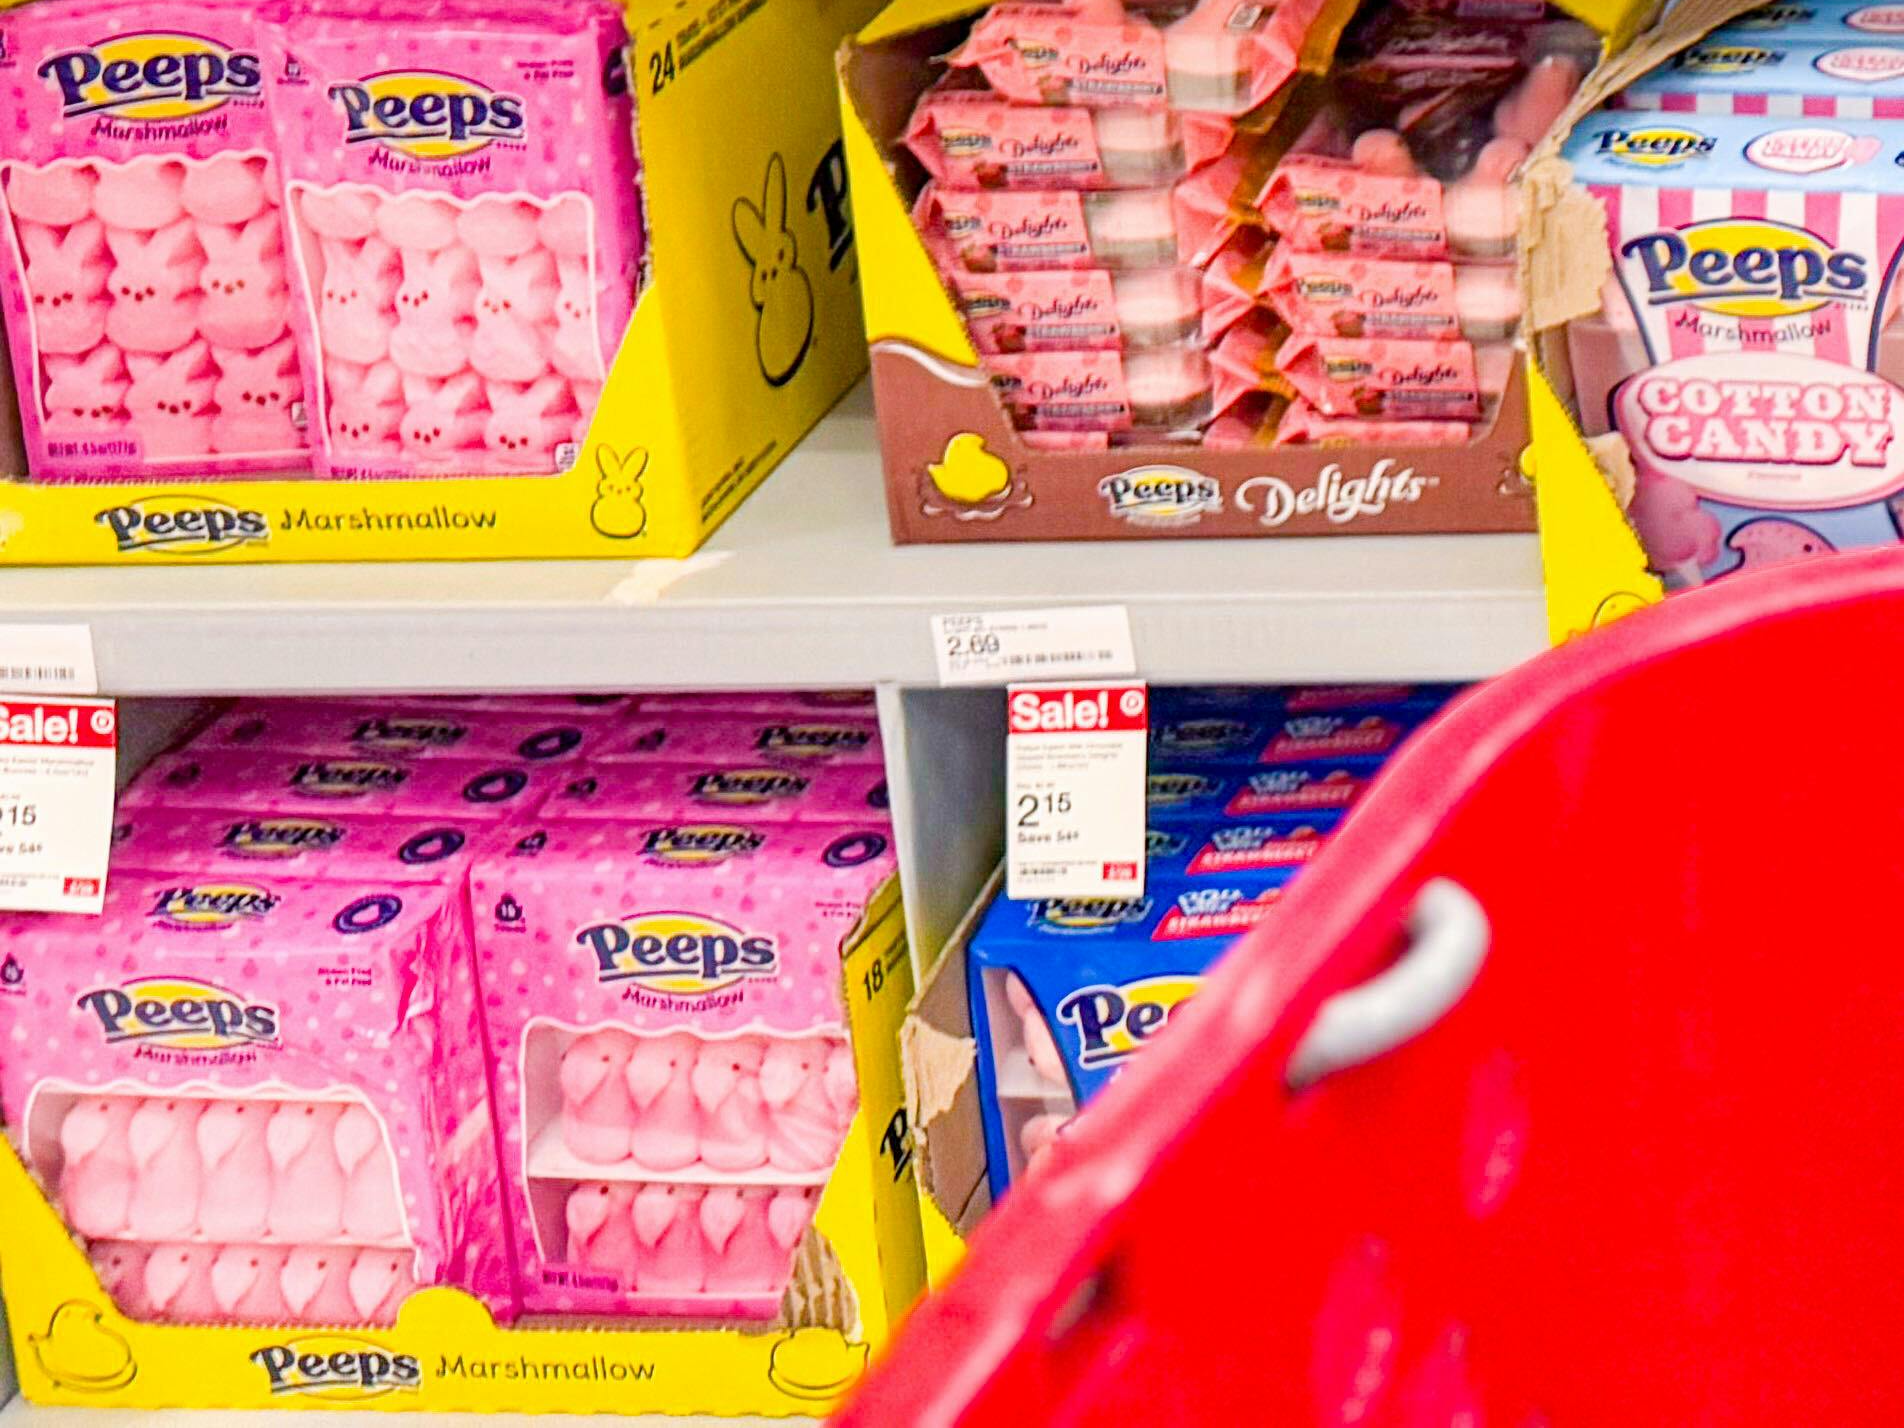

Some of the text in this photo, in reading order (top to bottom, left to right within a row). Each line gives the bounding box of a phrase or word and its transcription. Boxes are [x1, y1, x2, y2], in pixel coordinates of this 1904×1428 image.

[38, 51, 262, 110] Peeps
[649, 40, 676, 95] 24
[91, 117, 229, 142] Marshmallow
[328, 85, 524, 142] Peeps
[1596, 127, 1718, 158] Peeps
[1622, 226, 1868, 302] Peeps
[1674, 310, 1833, 347] Marshmallow
[1639, 378, 1895, 425] COTTON
[1646, 419, 1895, 469] CANDY
[1101, 457, 1431, 524] Peeps Delights
[97, 499, 498, 550] Peeps Marshmallow
[1011, 691, 1109, 730] Sale!
[577, 924, 777, 980] Peeps
[862, 959, 884, 1002] 18
[77, 986, 281, 1046] Peeps
[250, 1343, 657, 1392] Peeps Marshmallow
